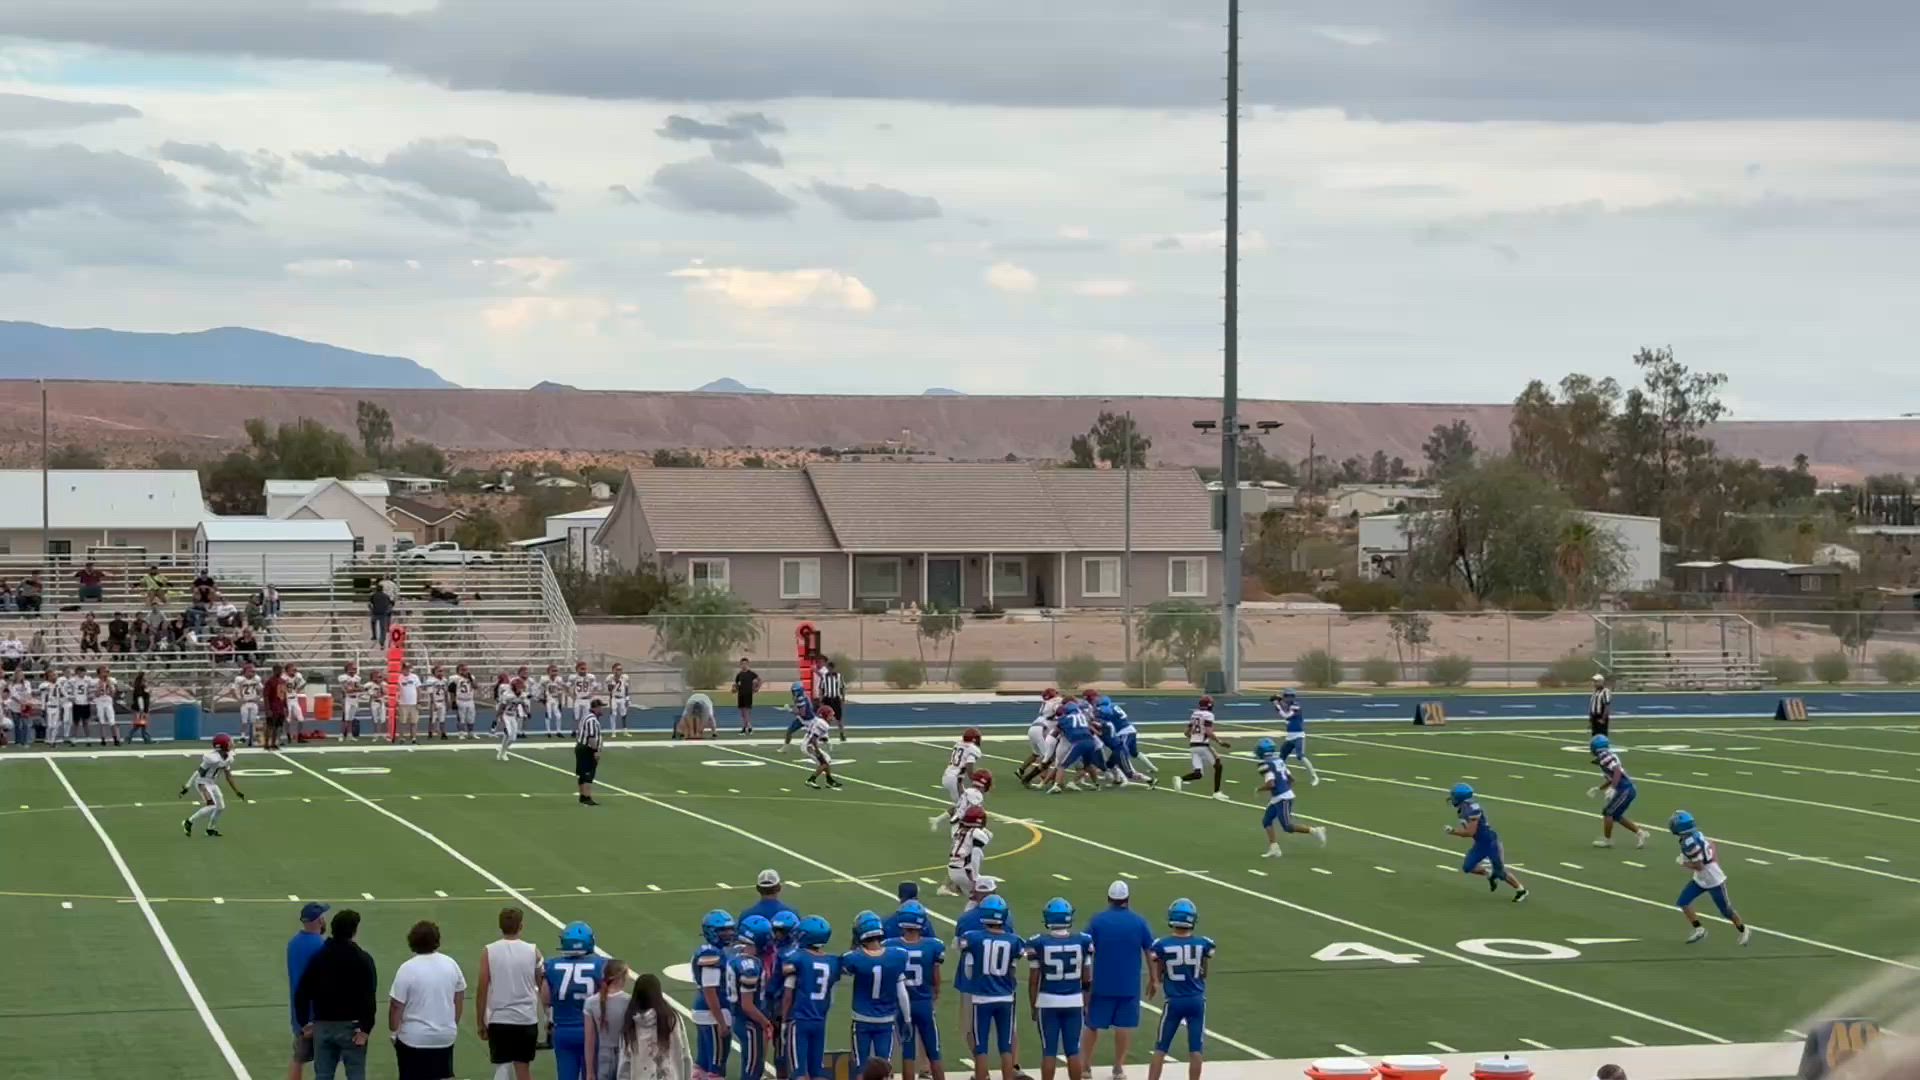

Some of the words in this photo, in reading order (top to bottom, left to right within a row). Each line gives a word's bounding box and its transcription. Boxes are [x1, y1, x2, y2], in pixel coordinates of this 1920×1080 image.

[1067, 714, 1088, 728] 70
[1424, 703, 1445, 725] 20
[1787, 698, 1806, 720] 10
[904, 951, 923, 987] 5
[982, 939, 1011, 976] 10
[1043, 945, 1082, 981] 53
[1164, 945, 1203, 981] 24
[553, 963, 596, 1001] 75
[810, 962, 831, 1001] 3
[871, 965, 882, 1000] 1
